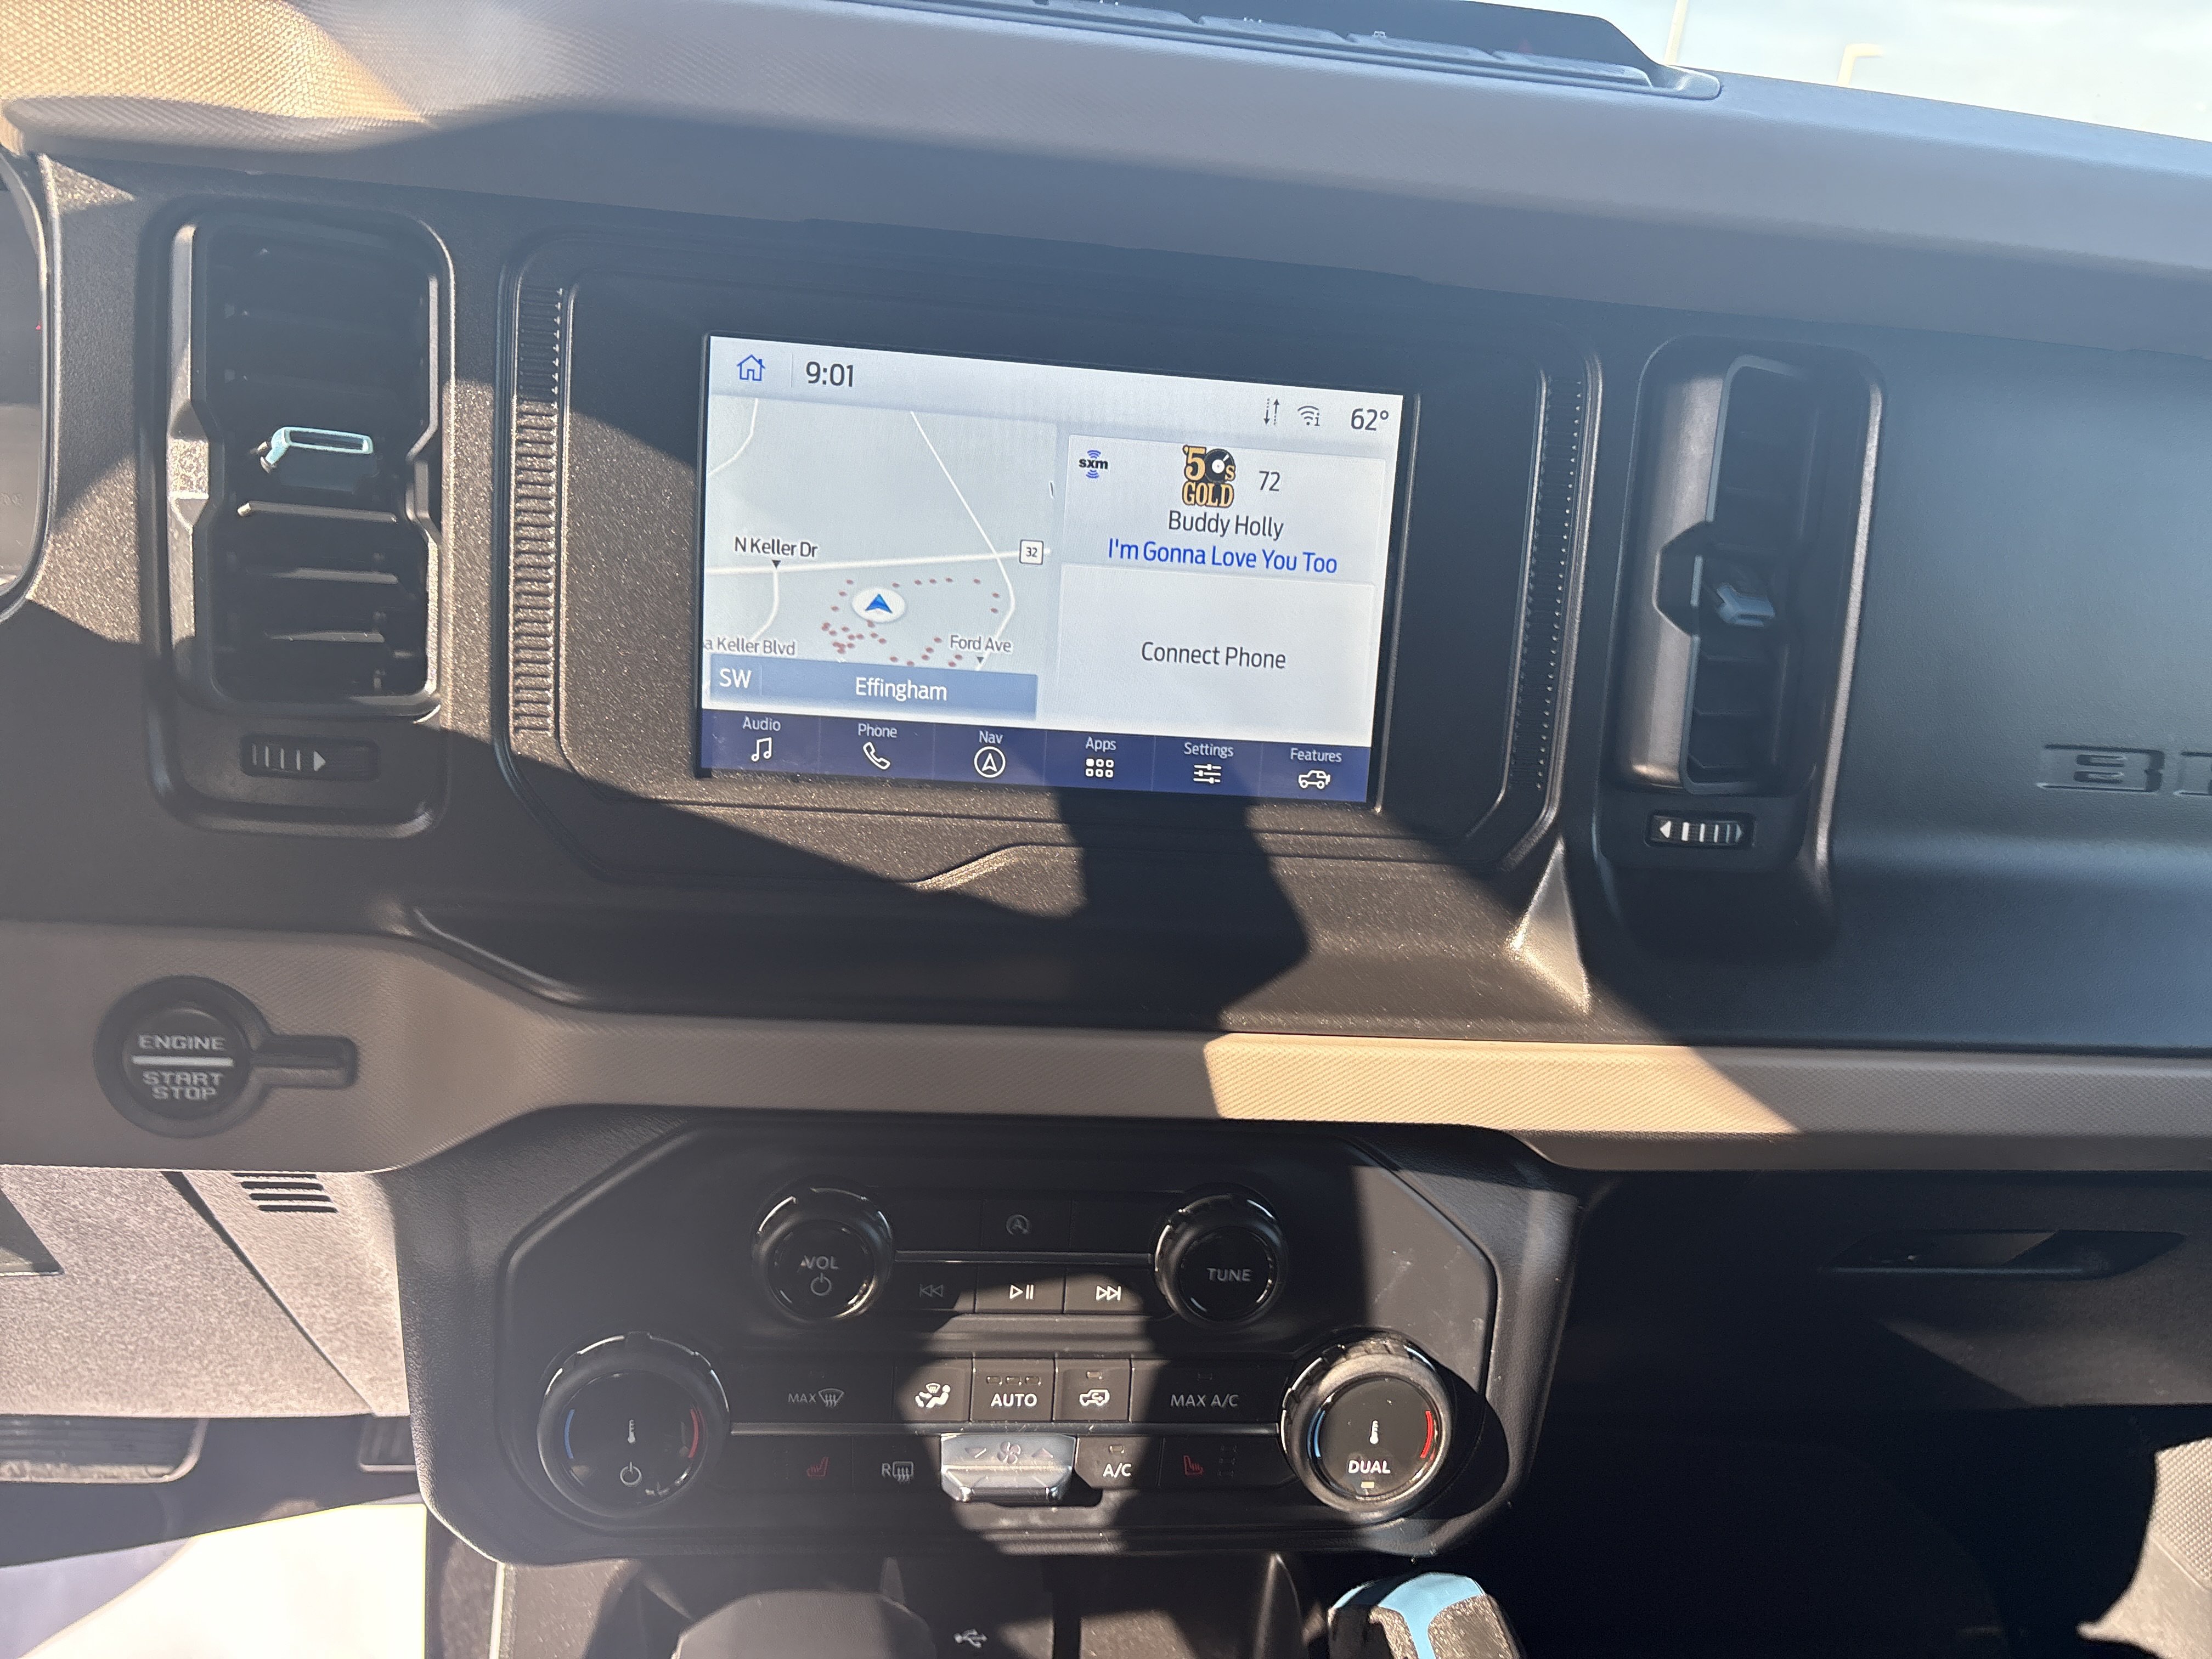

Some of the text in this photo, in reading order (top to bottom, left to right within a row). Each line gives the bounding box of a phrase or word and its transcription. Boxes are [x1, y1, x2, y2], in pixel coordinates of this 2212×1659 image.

[806, 361, 854, 387] 9:01
[1351, 408, 1389, 431] 62°
[1078, 459, 1108, 470] sxm
[1259, 471, 1280, 492] 72
[1182, 481, 1234, 509] GOLD
[1169, 510, 1284, 540] Buddy Holly
[734, 537, 818, 558] N Keller Dr
[1025, 546, 1039, 558] 32
[1108, 539, 1338, 574] I'm Gonna Love You Too
[716, 637, 760, 653] Keller
[763, 639, 796, 656] Blvd
[950, 635, 1012, 653] Ford Ave
[1141, 641, 1286, 669] Connect Phone
[719, 668, 753, 689] SW
[855, 677, 947, 703] Effingham
[742, 715, 781, 732] Audio
[857, 723, 898, 739] Phone
[979, 731, 1003, 744] Nav
[1085, 736, 1116, 752] Apps
[1183, 742, 1234, 759] Settings
[1290, 747, 1342, 763] Features
[138, 1035, 226, 1050] ENGINE
[143, 1071, 223, 1086] START
[153, 1087, 217, 1100] STOP
[804, 1255, 839, 1270] VOL
[1207, 1267, 1251, 1282] TUNE
[788, 1393, 816, 1404] MAX
[991, 1392, 1037, 1407] AUTO
[1170, 1393, 1239, 1408] MAX A/C
[882, 1463, 891, 1476] R
[1103, 1463, 1132, 1478] A/C
[1347, 1459, 1391, 1474] DUAL
